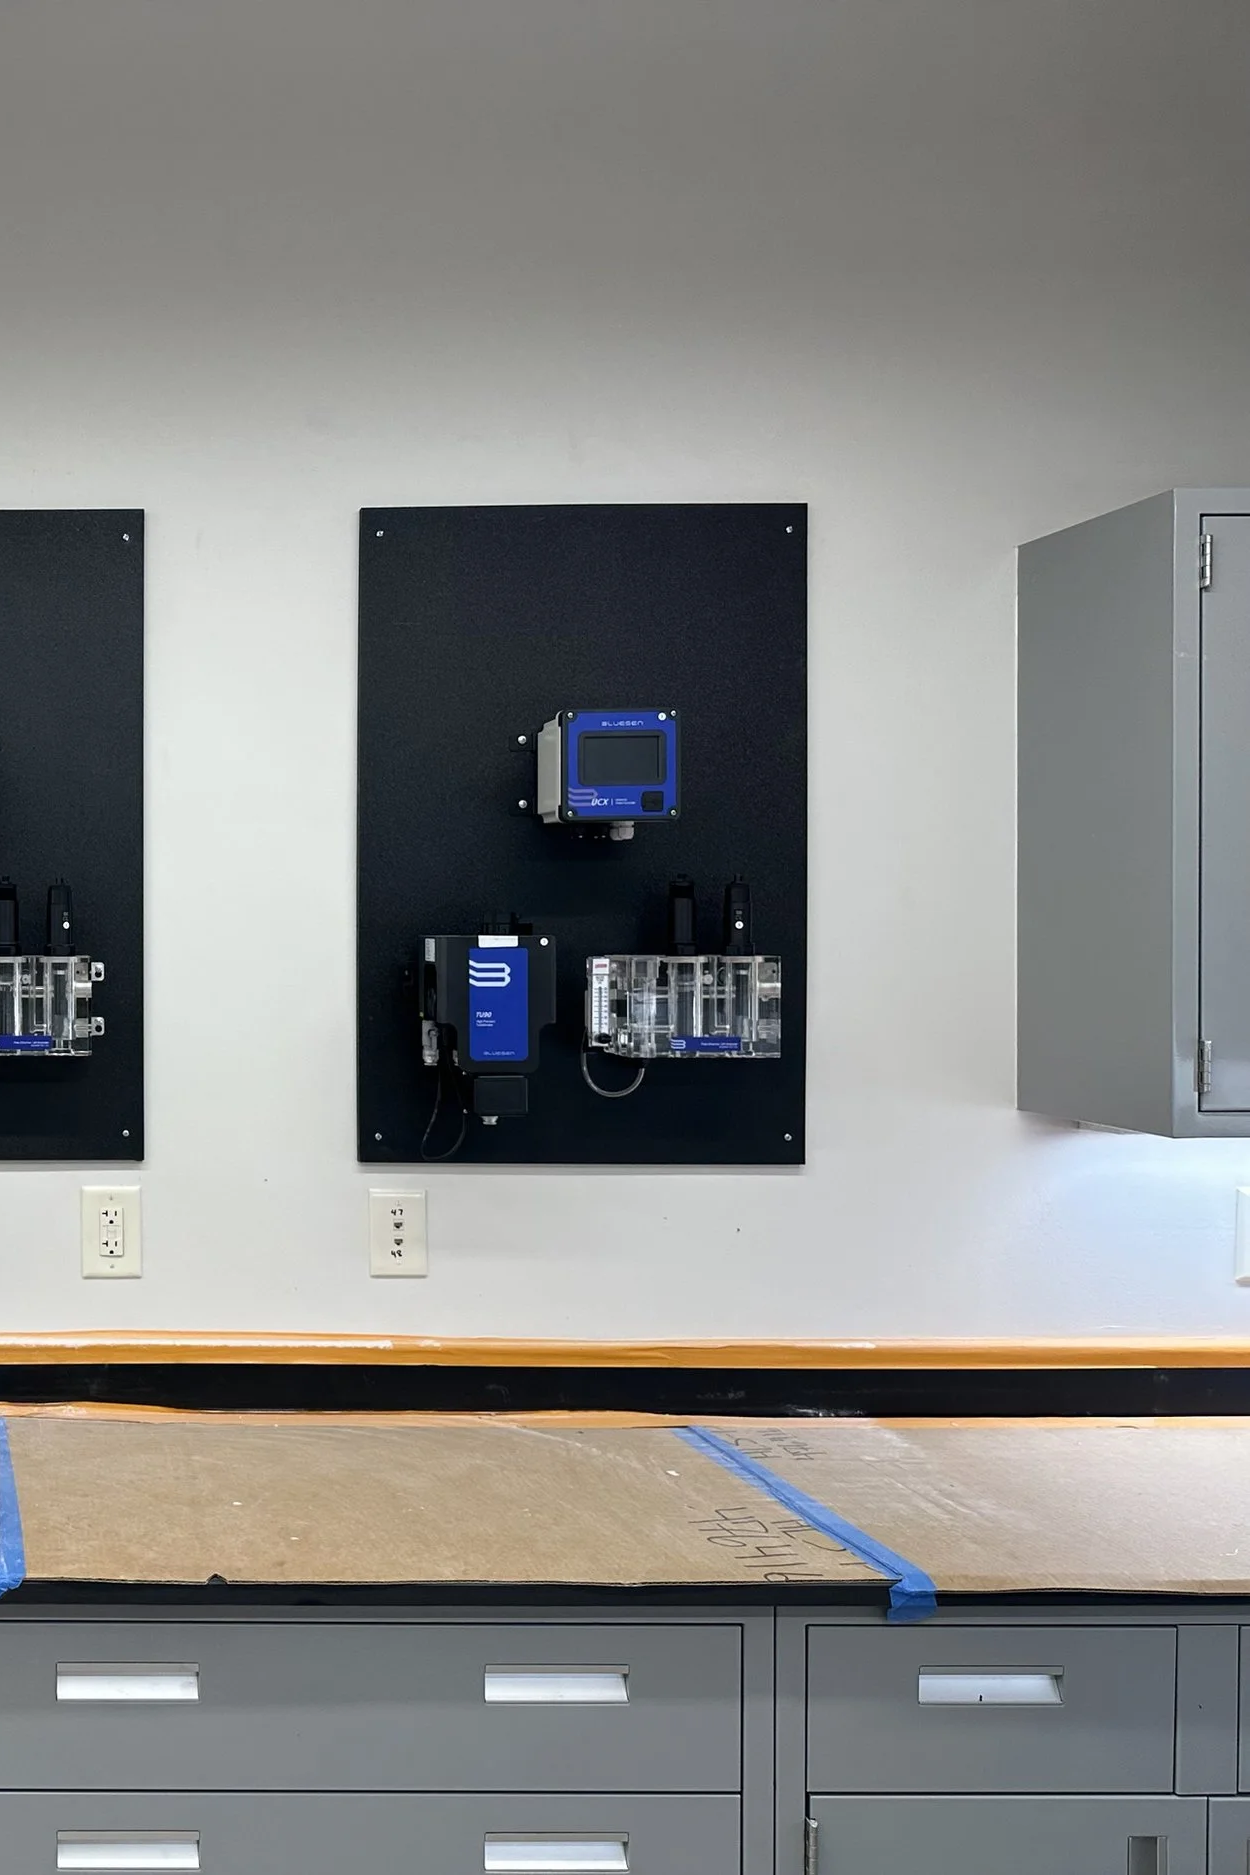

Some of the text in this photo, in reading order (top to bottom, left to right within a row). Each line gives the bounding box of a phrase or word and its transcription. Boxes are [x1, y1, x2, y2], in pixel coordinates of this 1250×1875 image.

[591, 798, 609, 806] UCX
[390, 1208, 404, 1216] 47
[390, 1249, 403, 1258] 48
